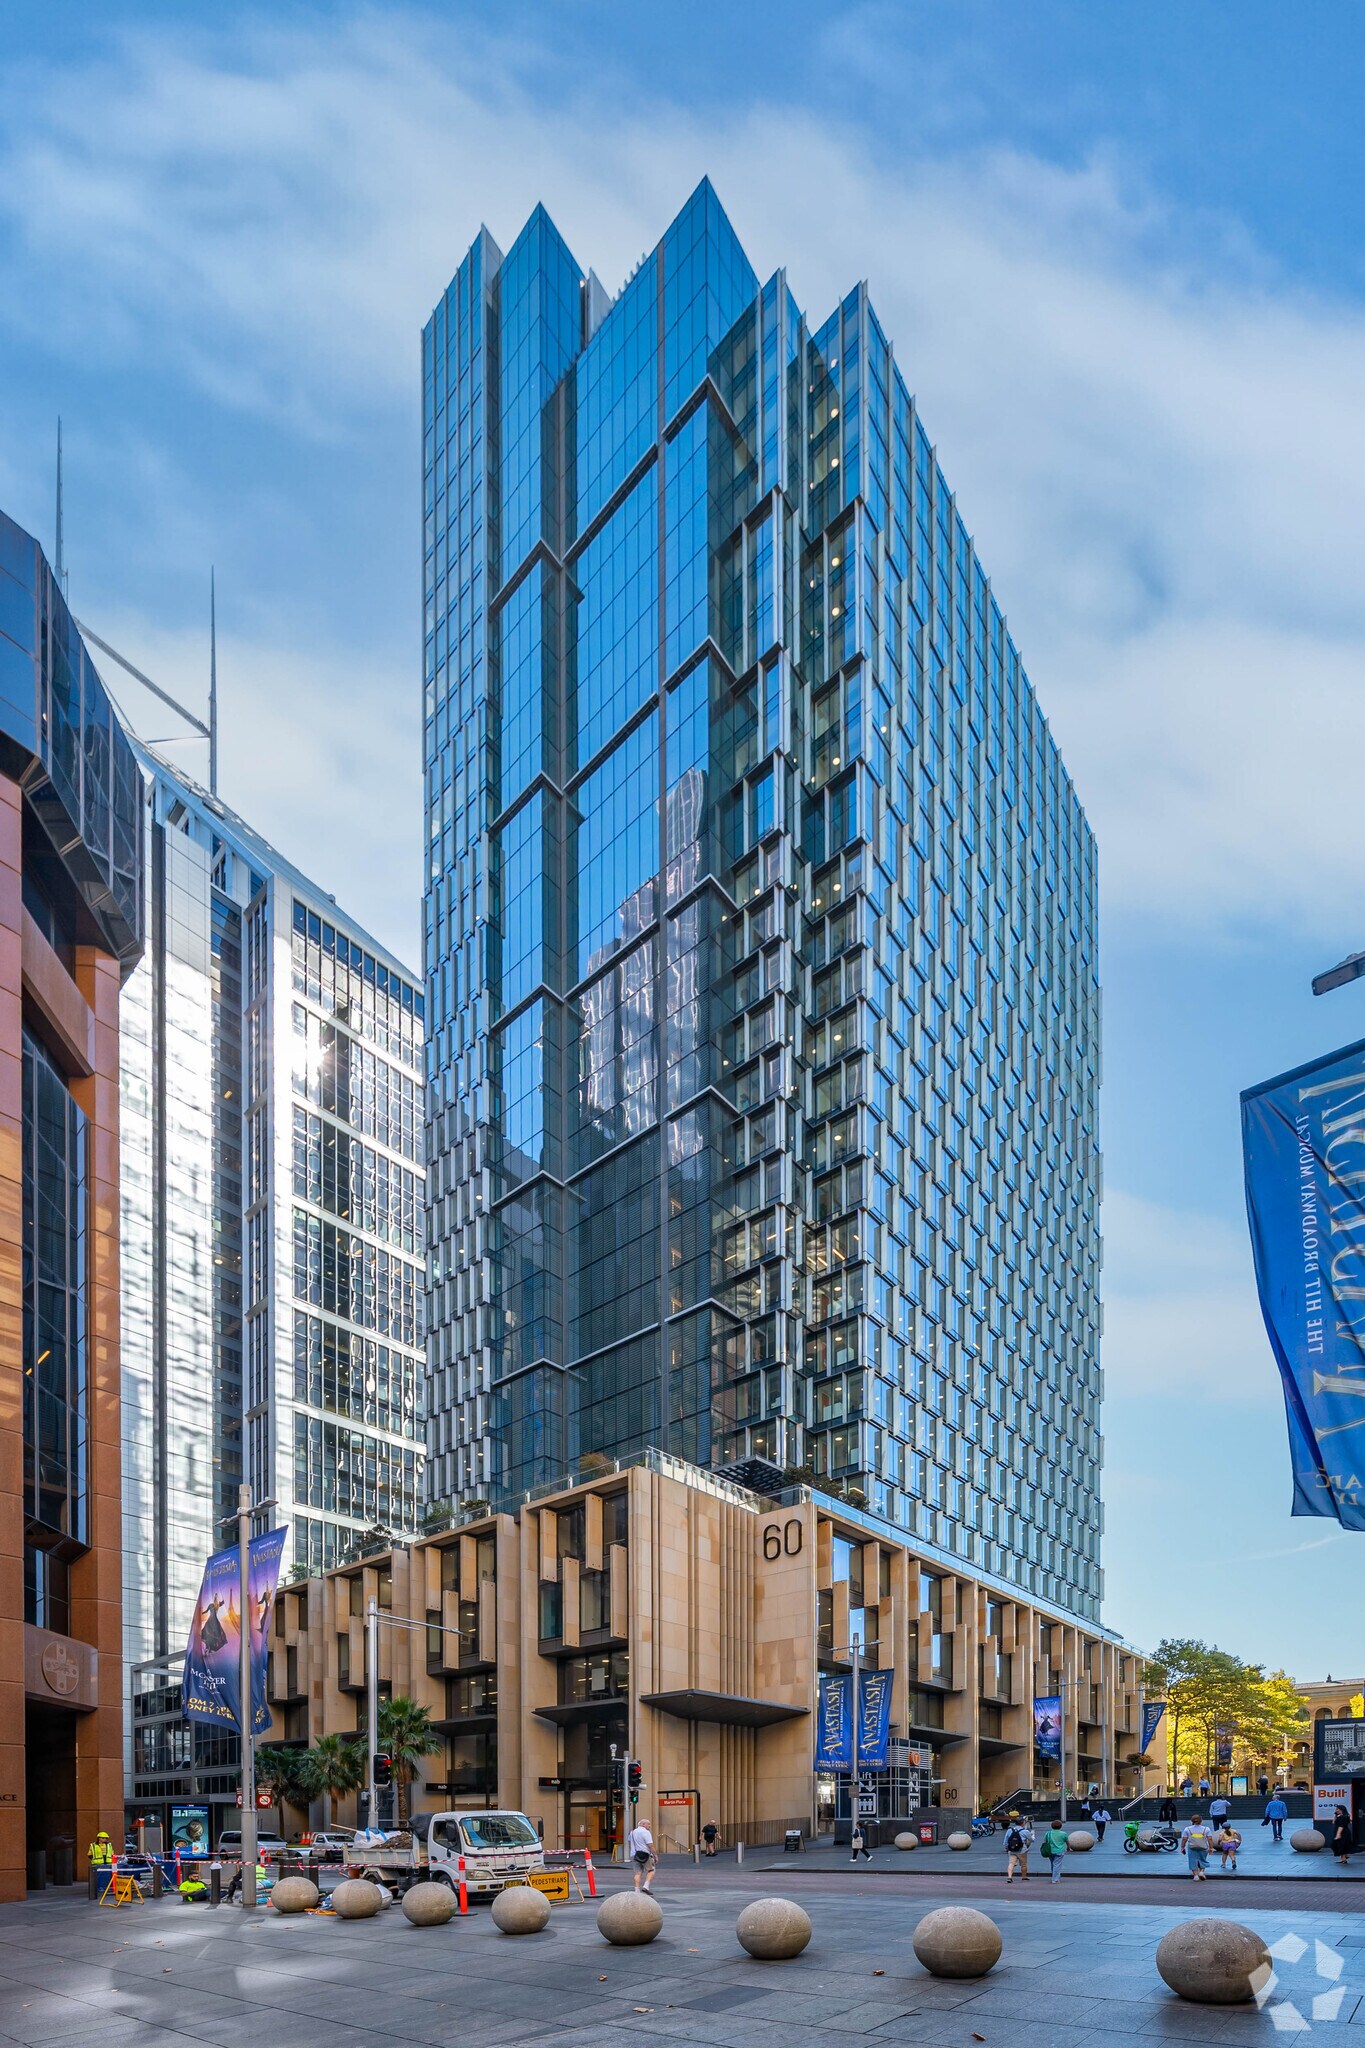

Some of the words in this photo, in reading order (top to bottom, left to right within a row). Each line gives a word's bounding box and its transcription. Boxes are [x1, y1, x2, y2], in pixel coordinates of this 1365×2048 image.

[763, 1518, 803, 1560] 60
[822, 1680, 844, 1756] ANASTASIA
[859, 1675, 887, 1755] ANASTASIA
[857, 1771, 873, 1780] Lift
[944, 1788, 958, 1800] 60
[1317, 1789, 1348, 1798] Built
[531, 1876, 567, 1886] PEDESTRIANS
